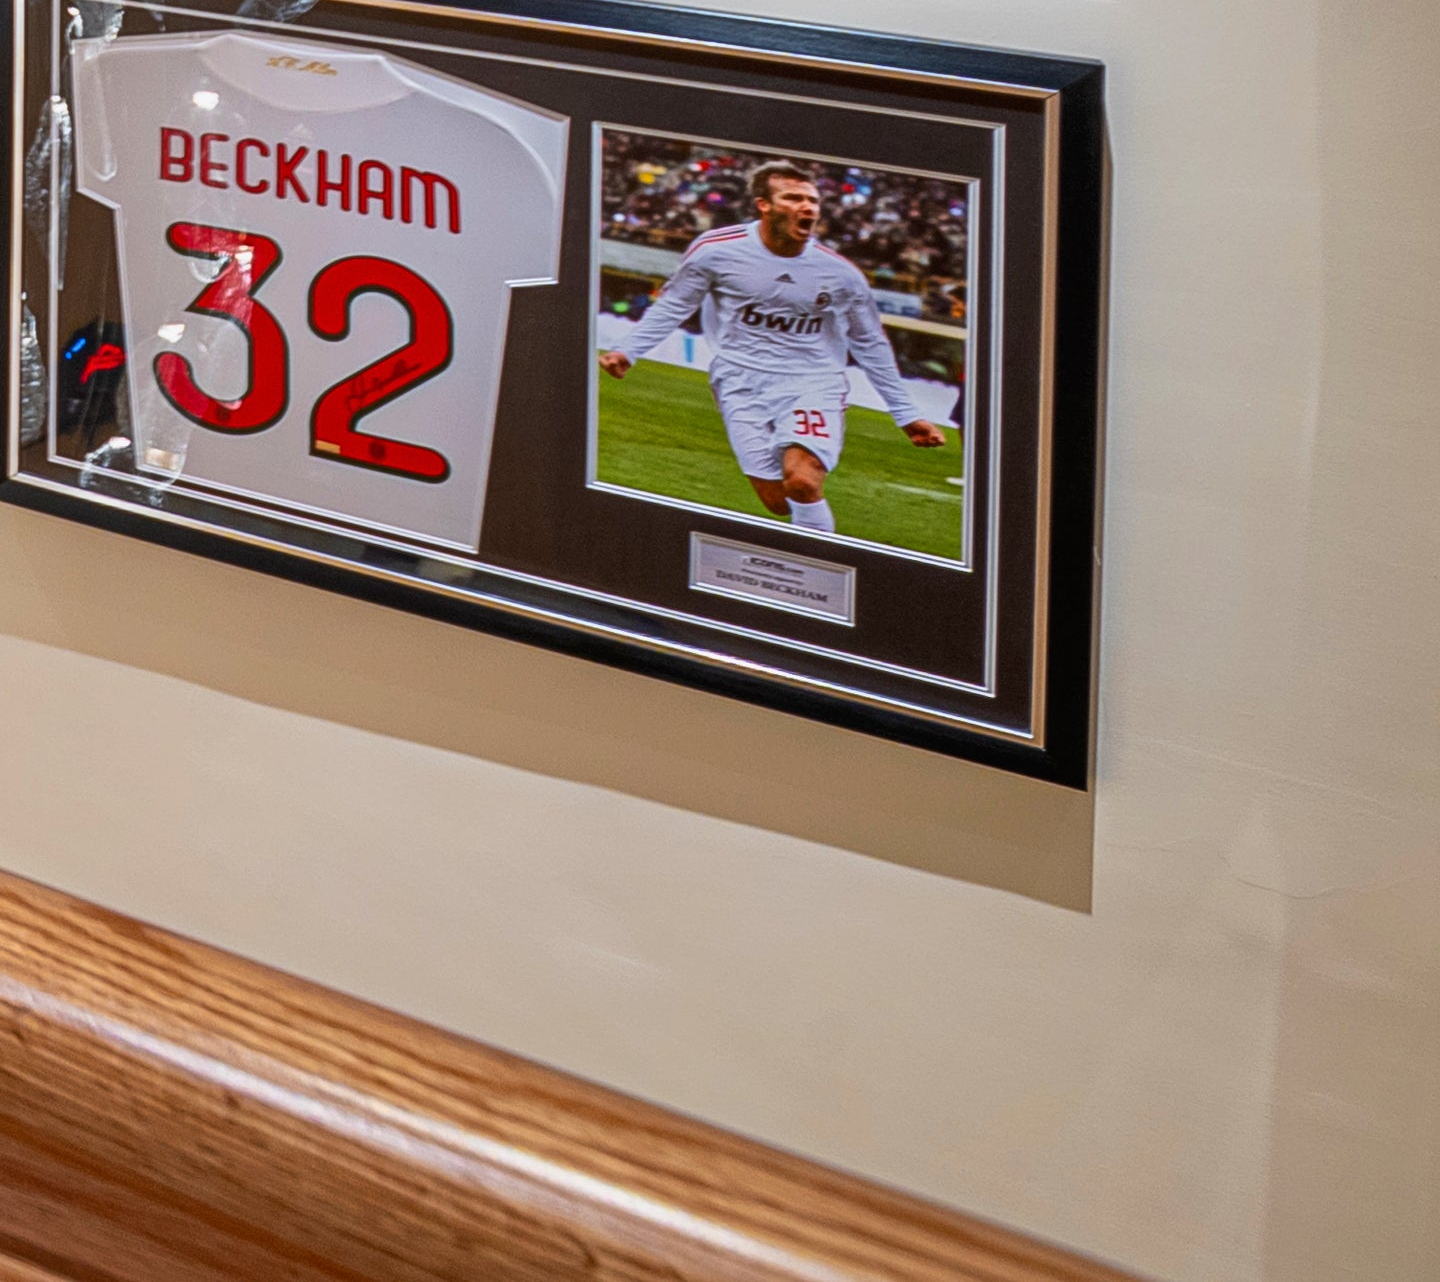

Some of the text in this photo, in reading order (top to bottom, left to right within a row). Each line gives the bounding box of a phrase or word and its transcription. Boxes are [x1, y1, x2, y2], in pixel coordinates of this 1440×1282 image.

[159, 126, 462, 235] BECKHAM
[152, 221, 454, 484] 32
[740, 301, 824, 335] bwin
[792, 409, 831, 439] 32
